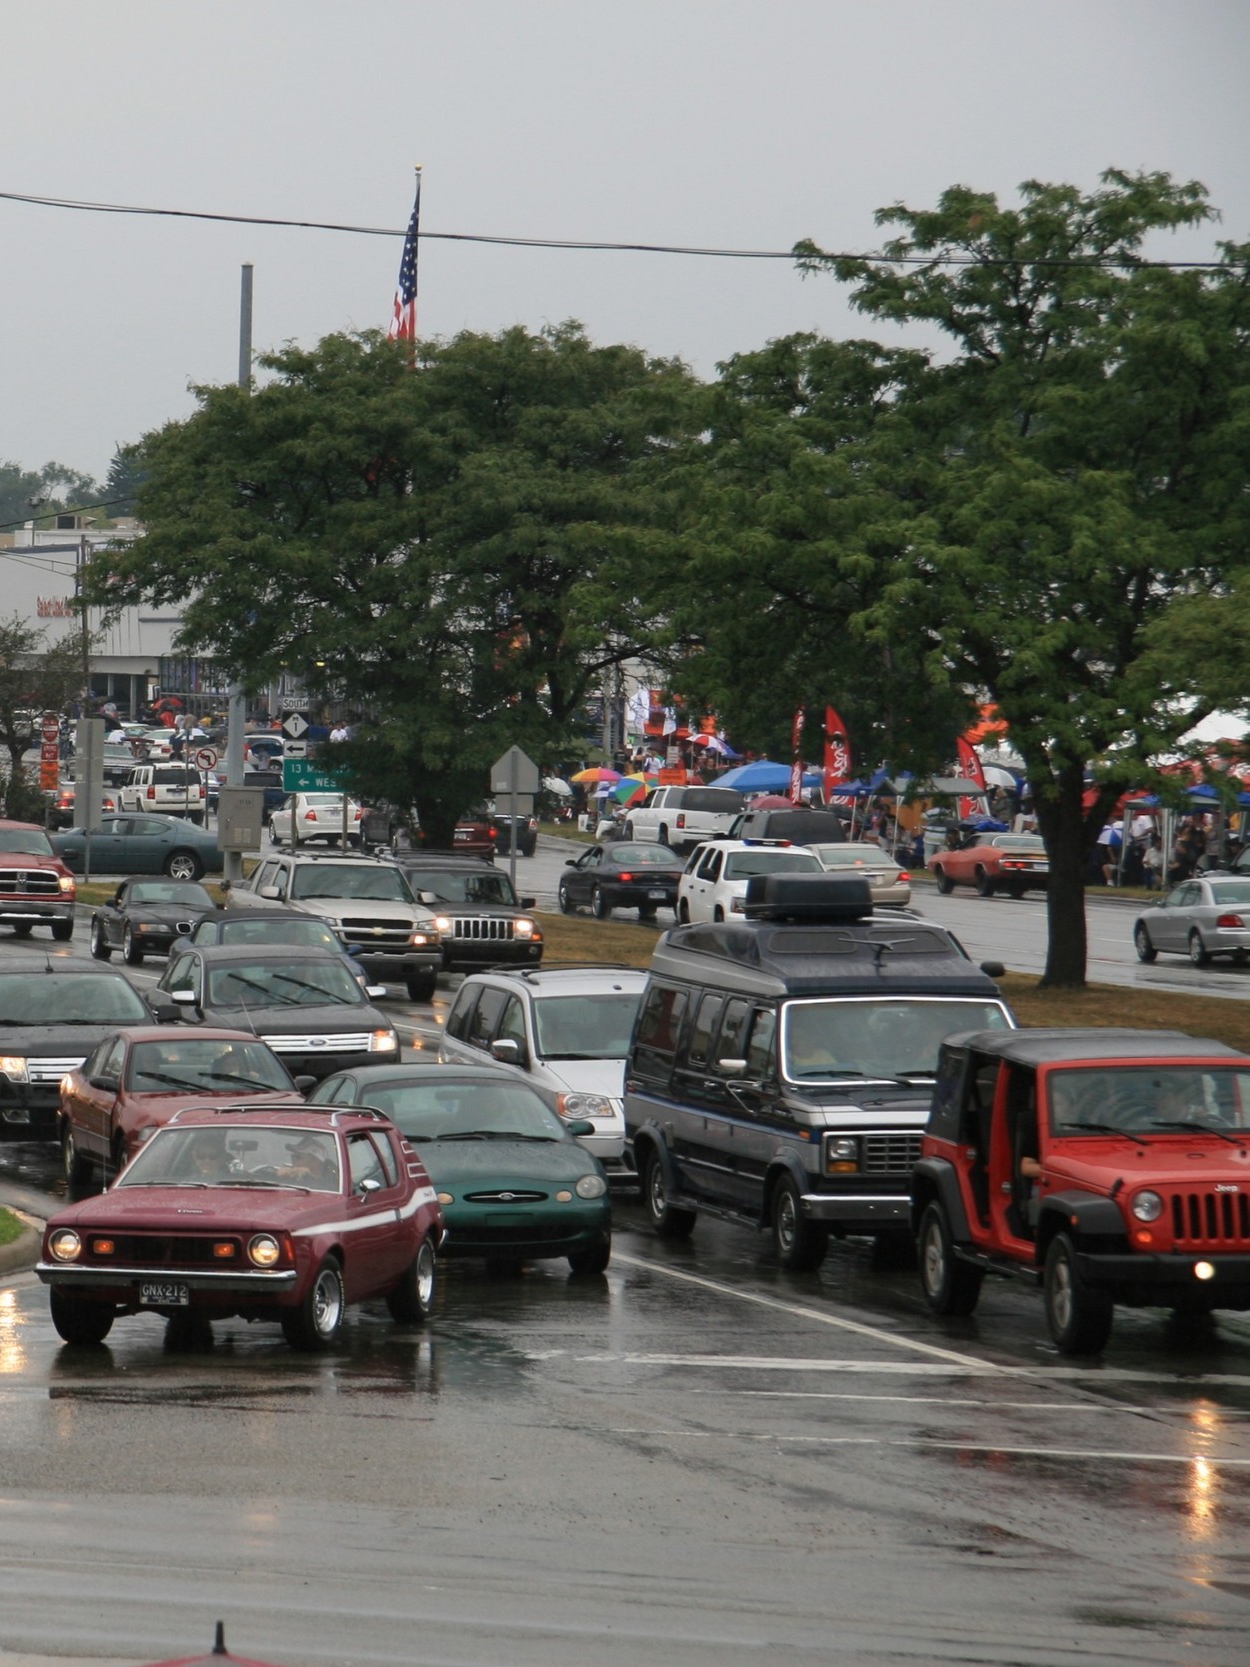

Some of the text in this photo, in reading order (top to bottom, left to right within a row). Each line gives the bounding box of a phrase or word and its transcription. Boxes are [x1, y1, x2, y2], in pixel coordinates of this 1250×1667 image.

[283, 699, 309, 709] SOUTH
[291, 764, 302, 773] 13
[315, 778, 337, 788] WES
[1214, 1183, 1239, 1193] Jeep
